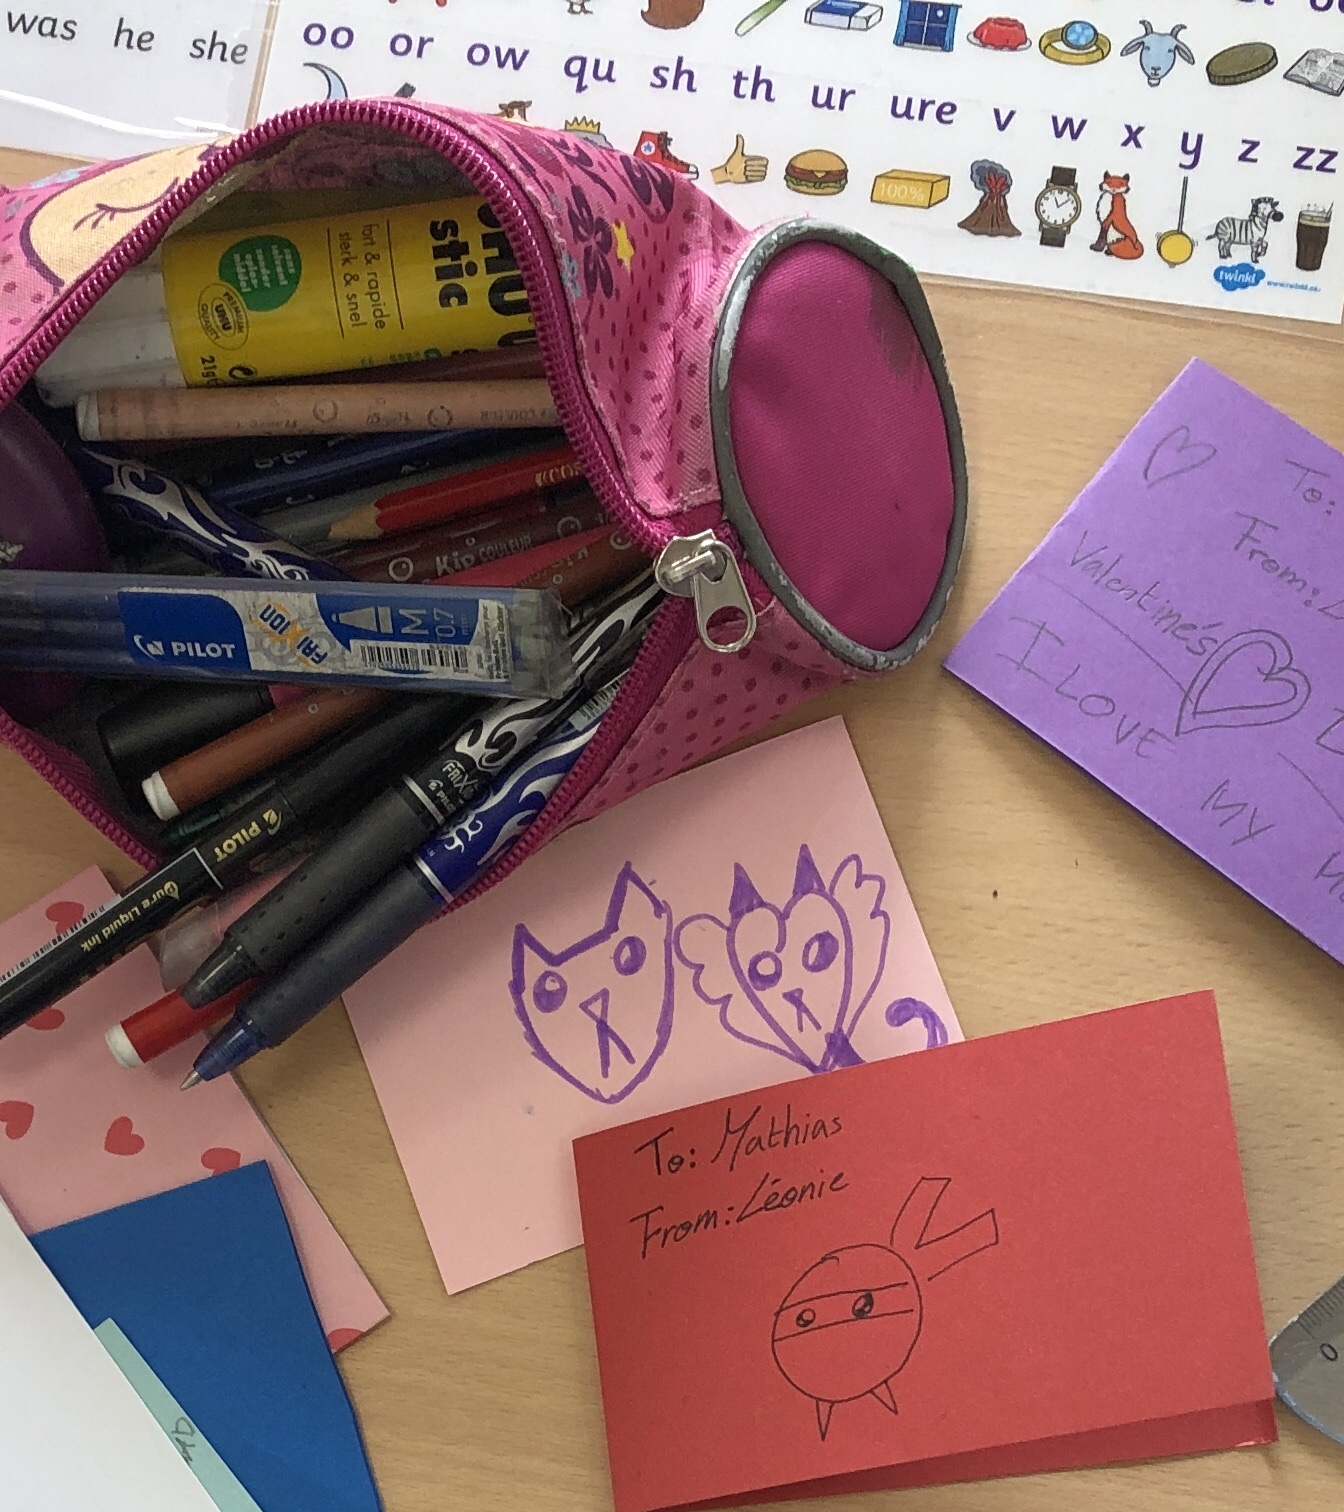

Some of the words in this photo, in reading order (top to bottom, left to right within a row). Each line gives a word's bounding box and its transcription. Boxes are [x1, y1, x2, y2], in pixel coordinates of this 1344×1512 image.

[6, 10, 78, 41] was
[114, 18, 155, 53] he
[189, 32, 249, 66] she
[302, 23, 355, 49] oo
[389, 33, 434, 60] or
[466, 43, 529, 71] ow
[563, 54, 616, 95] qu
[649, 56, 698, 93] sh
[732, 66, 776, 102] th
[810, 83, 856, 112] ur
[889, 94, 958, 125] ure
[992, 107, 1017, 132] v
[1051, 115, 1087, 142] w
[1120, 124, 1145, 149] x
[1179, 131, 1204, 170] y
[1237, 139, 1261, 164] z
[1292, 145, 1340, 174] zz
[880, 182, 925, 202] 100%
[429, 219, 478, 308] stic
[1219, 270, 1257, 284] twinkl
[345, 292, 368, 328] snel
[365, 271, 391, 330] rapide
[1285, 457, 1338, 516] To:
[478, 533, 533, 562] COULEUR
[1234, 511, 1321, 608] From:
[1069, 530, 1225, 657] Valentine's
[171, 640, 236, 659] PILOT
[398, 608, 428, 636] M
[432, 607, 456, 638] 0.7
[996, 615, 1066, 684] I
[1054, 662, 1179, 760] LOVE
[213, 820, 262, 863] PILOT
[101, 906, 141, 939] Liquid
[632, 1126, 699, 1176] To:
[710, 1102, 844, 1172] Mathias
[628, 1204, 735, 1261] From:
[732, 1168, 851, 1223] Léonie
[1320, 1342, 1339, 1362] 0
